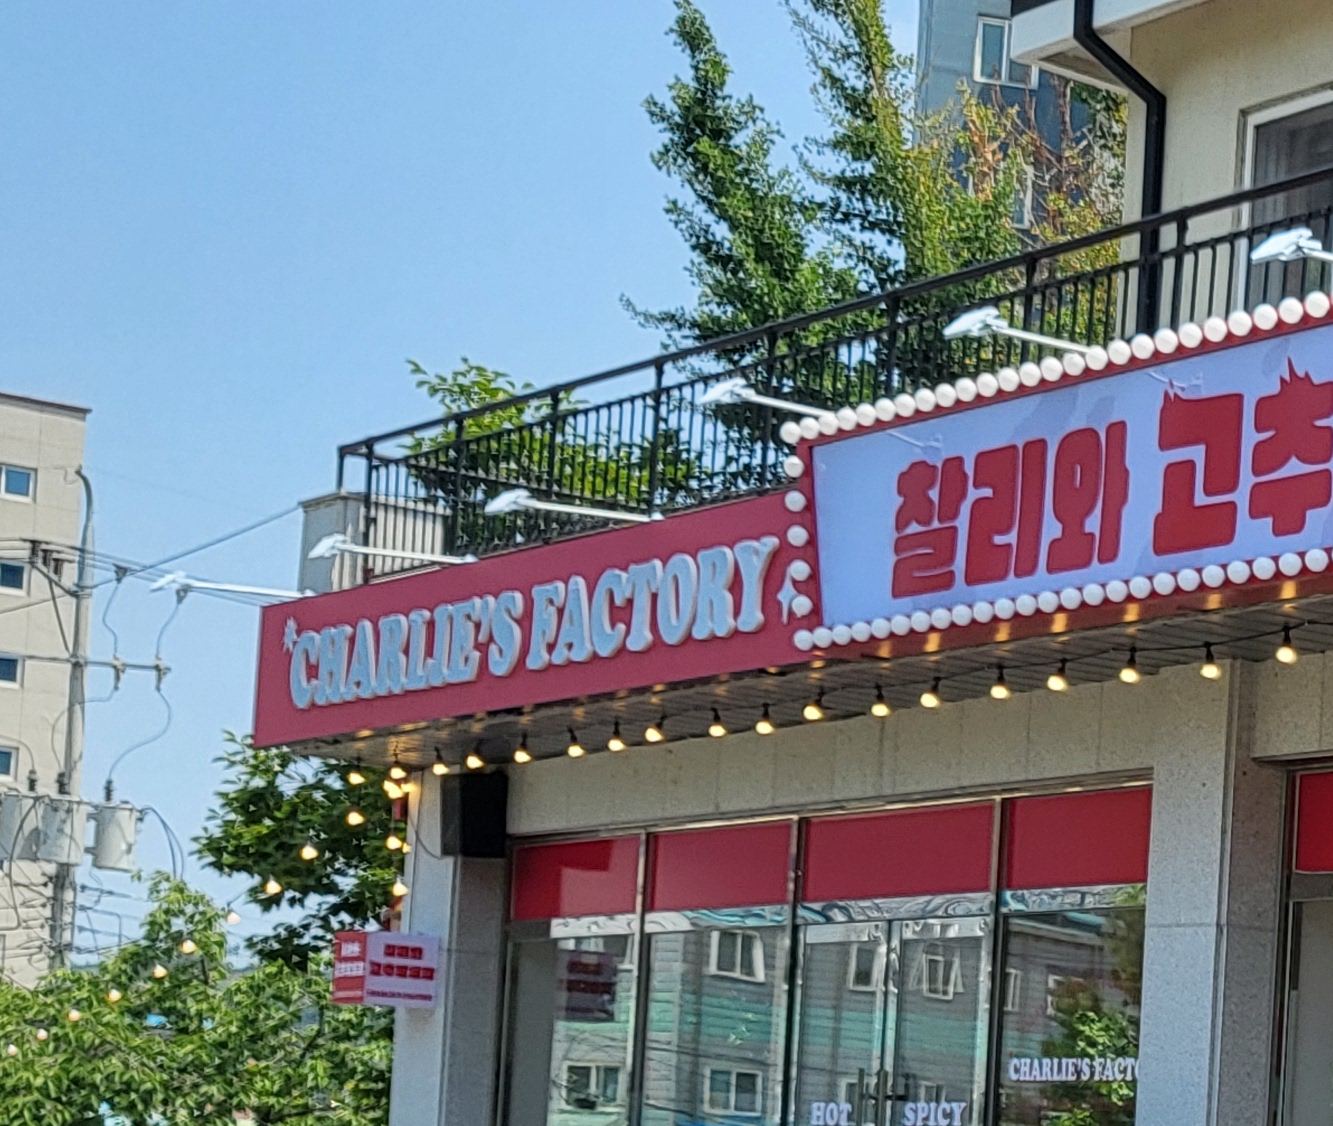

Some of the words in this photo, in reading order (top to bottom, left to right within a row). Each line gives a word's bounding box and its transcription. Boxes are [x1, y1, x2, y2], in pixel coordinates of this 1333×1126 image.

[890, 418, 1128, 600] 찰리와
[289, 589, 525, 709] CHARLIE'S
[526, 535, 780, 671] FACTORY
[810, 1101, 853, 1126] HOT
[1009, 1057, 1091, 1081] CHARLIE'S
